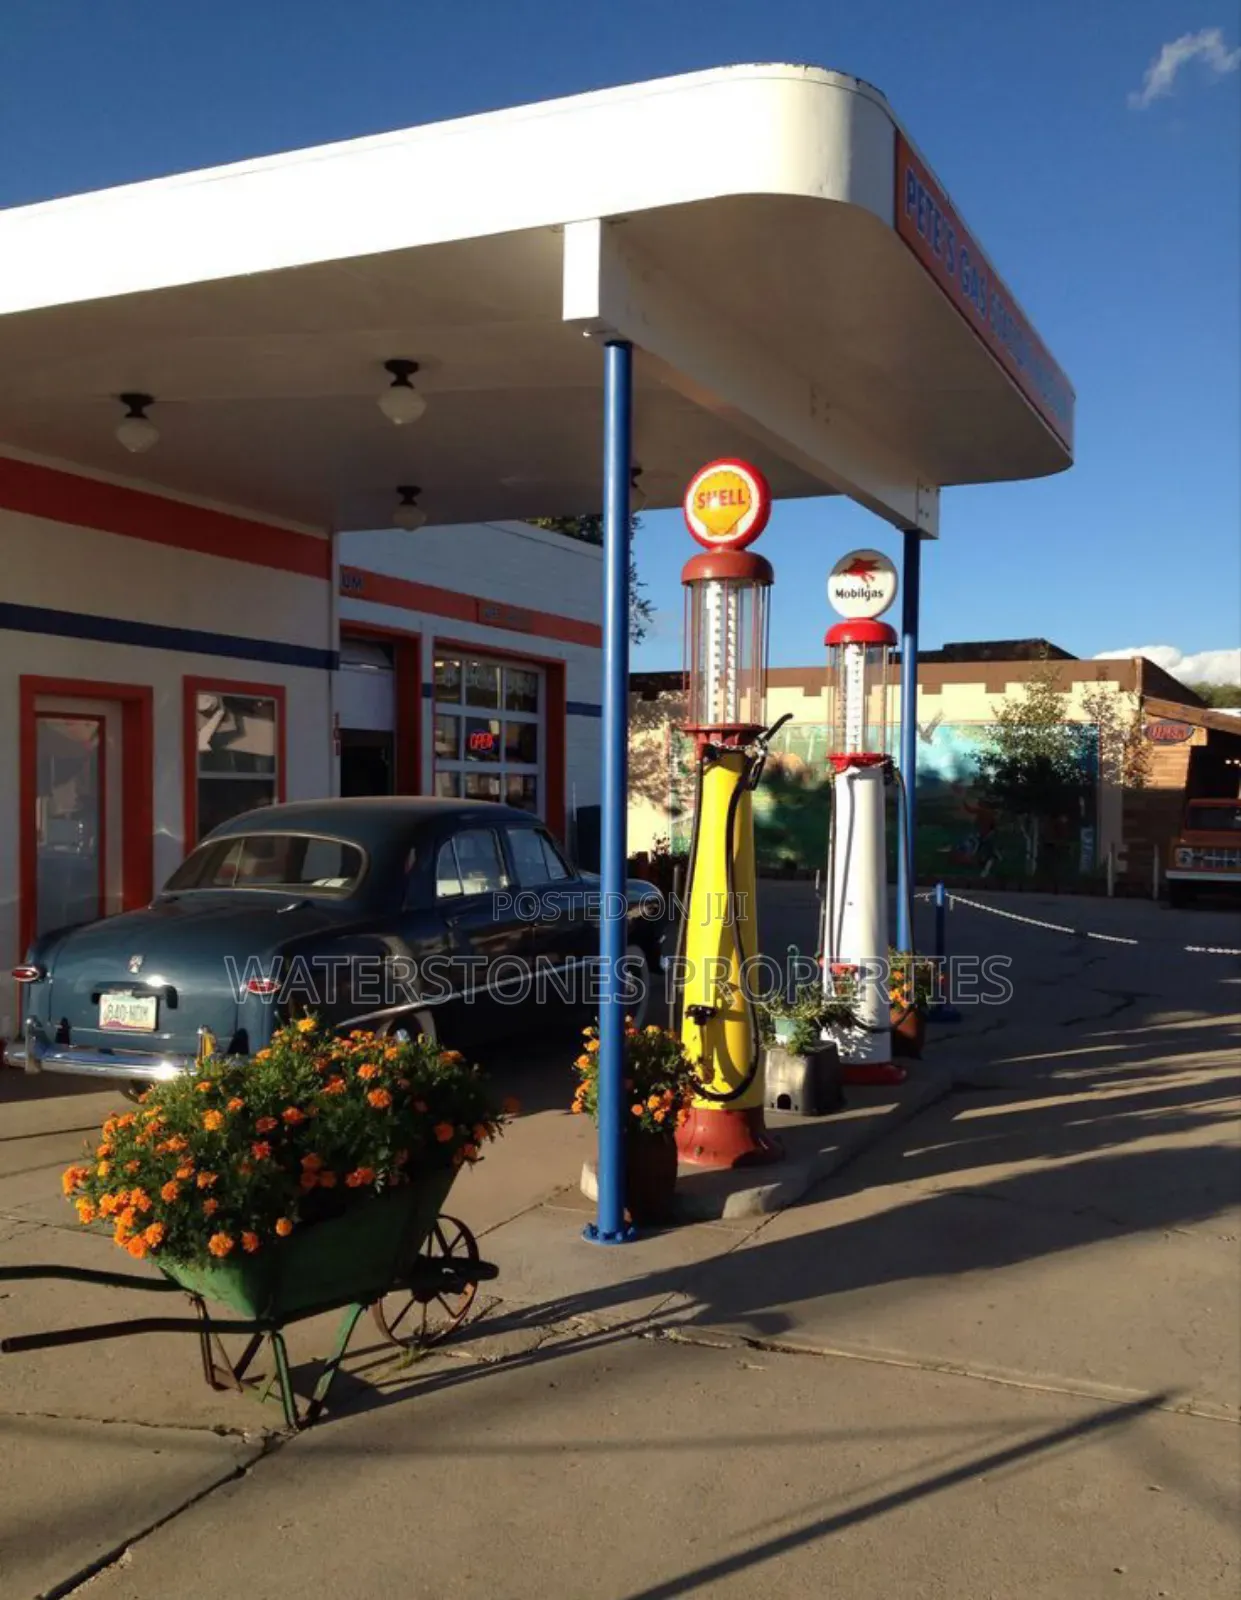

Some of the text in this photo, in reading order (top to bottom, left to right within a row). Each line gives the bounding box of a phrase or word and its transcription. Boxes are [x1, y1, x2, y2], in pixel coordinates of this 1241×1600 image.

[959, 245, 988, 320] GAS
[697, 488, 745, 510] SHELL
[835, 587, 884, 601] Mobilgas
